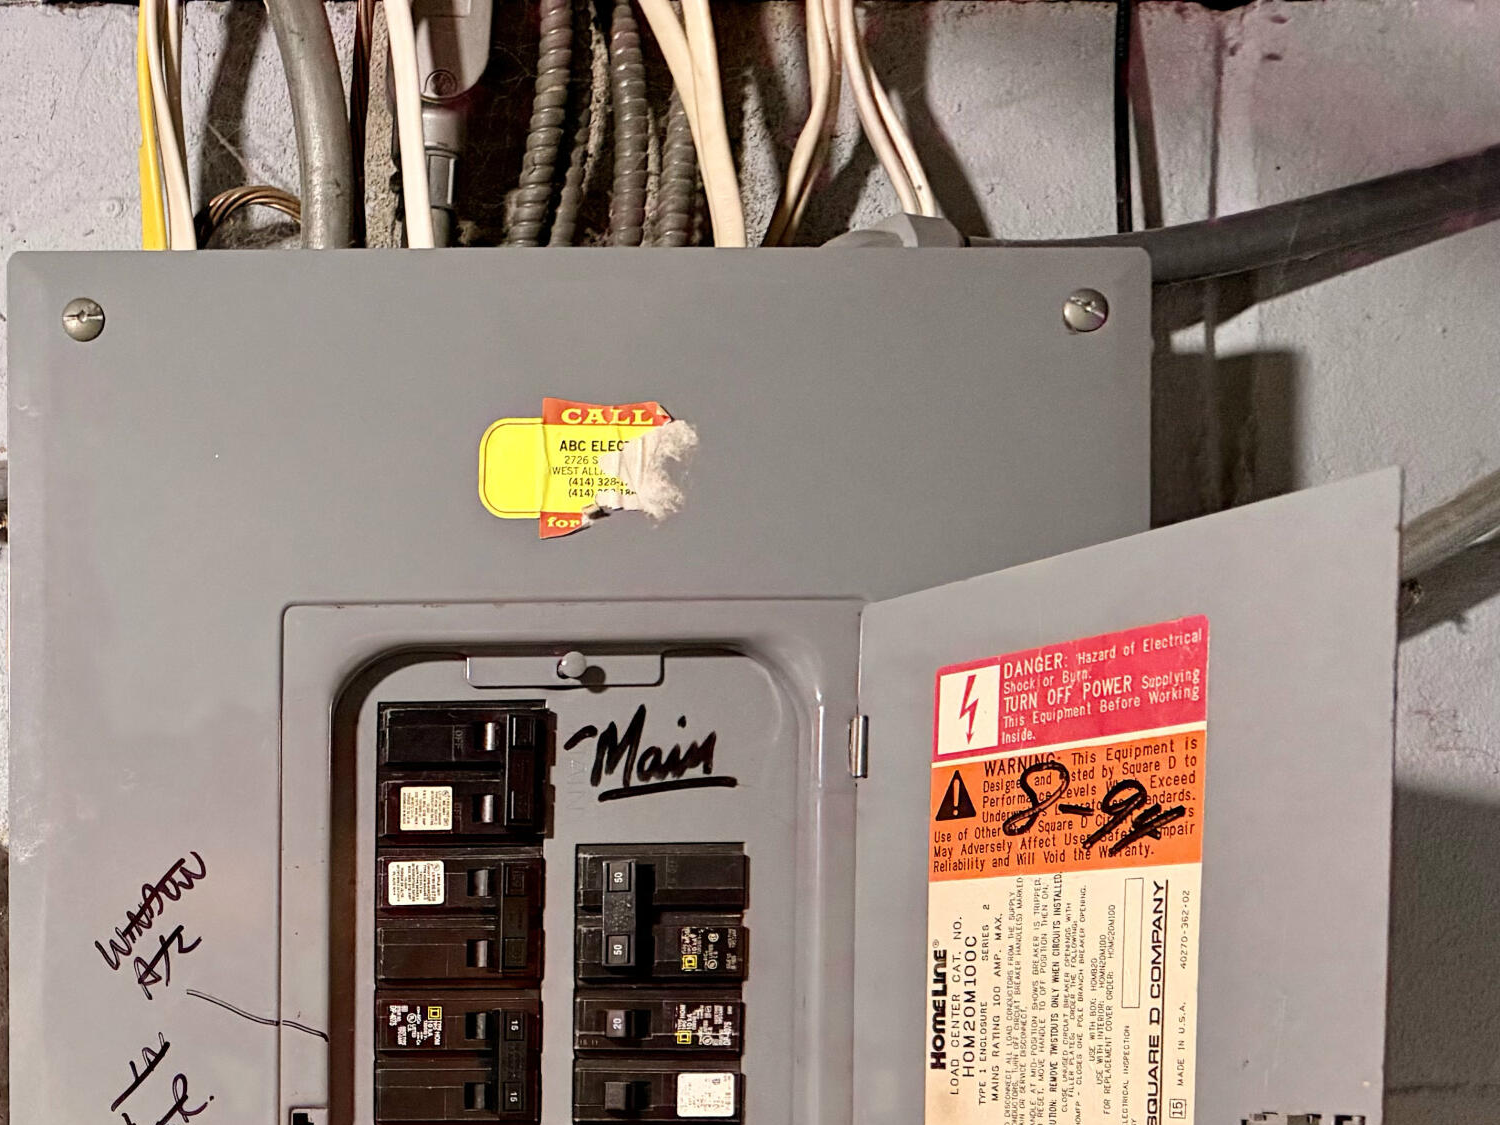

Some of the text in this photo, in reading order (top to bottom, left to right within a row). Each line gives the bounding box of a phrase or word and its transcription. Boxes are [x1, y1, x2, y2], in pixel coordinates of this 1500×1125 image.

[561, 409, 653, 424] CALL
[560, 441, 586, 451] ABC
[553, 467, 579, 475] WEST
[564, 456, 598, 464] 2726 S
[568, 478, 594, 487] (414)
[568, 489, 594, 498] (414)
[547, 517, 581, 527] for
[1003, 628, 1201, 679] DANGER: Hazard of Electrical
[1003, 668, 1092, 694] Shock or Burn.
[1004, 668, 1200, 712] TURN OFF POWER Supplying
[1003, 686, 1199, 728] This Equipment Before Working
[591, 704, 716, 787] Main
[1002, 730, 1035, 744] Inside.
[1072, 737, 1197, 765] This Equipment is
[1034, 754, 1196, 786] and by Square D to
[1150, 770, 1195, 788] Exceed
[934, 815, 1087, 843] Use of Other Square D
[934, 835, 1056, 859] May Adversely Affect
[934, 848, 1091, 872] Reliability and Will Void the
[614, 872, 623, 883] 50
[613, 944, 622, 956] 50
[1150, 880, 1164, 998] COMPANY
[994, 950, 1002, 976] AMP.
[951, 916, 961, 1095] LOAD CENTER CAT. NO.
[963, 935, 977, 1077] HOM20M100C
[993, 986, 1001, 1006] 100
[511, 1020, 519, 1031] 15
[612, 1018, 622, 1029] 20
[1149, 1007, 1160, 1025] D
[980, 1002, 988, 1061] ENCLOSURE
[992, 1015, 1001, 1057] RATING
[1177, 1002, 1186, 1086] MADE IN U.S.A.
[979, 1081, 987, 1105] TYPE
[992, 1065, 1000, 1102] MAINS
[510, 1091, 518, 1102] 15
[1171, 1101, 1184, 1116] 15
